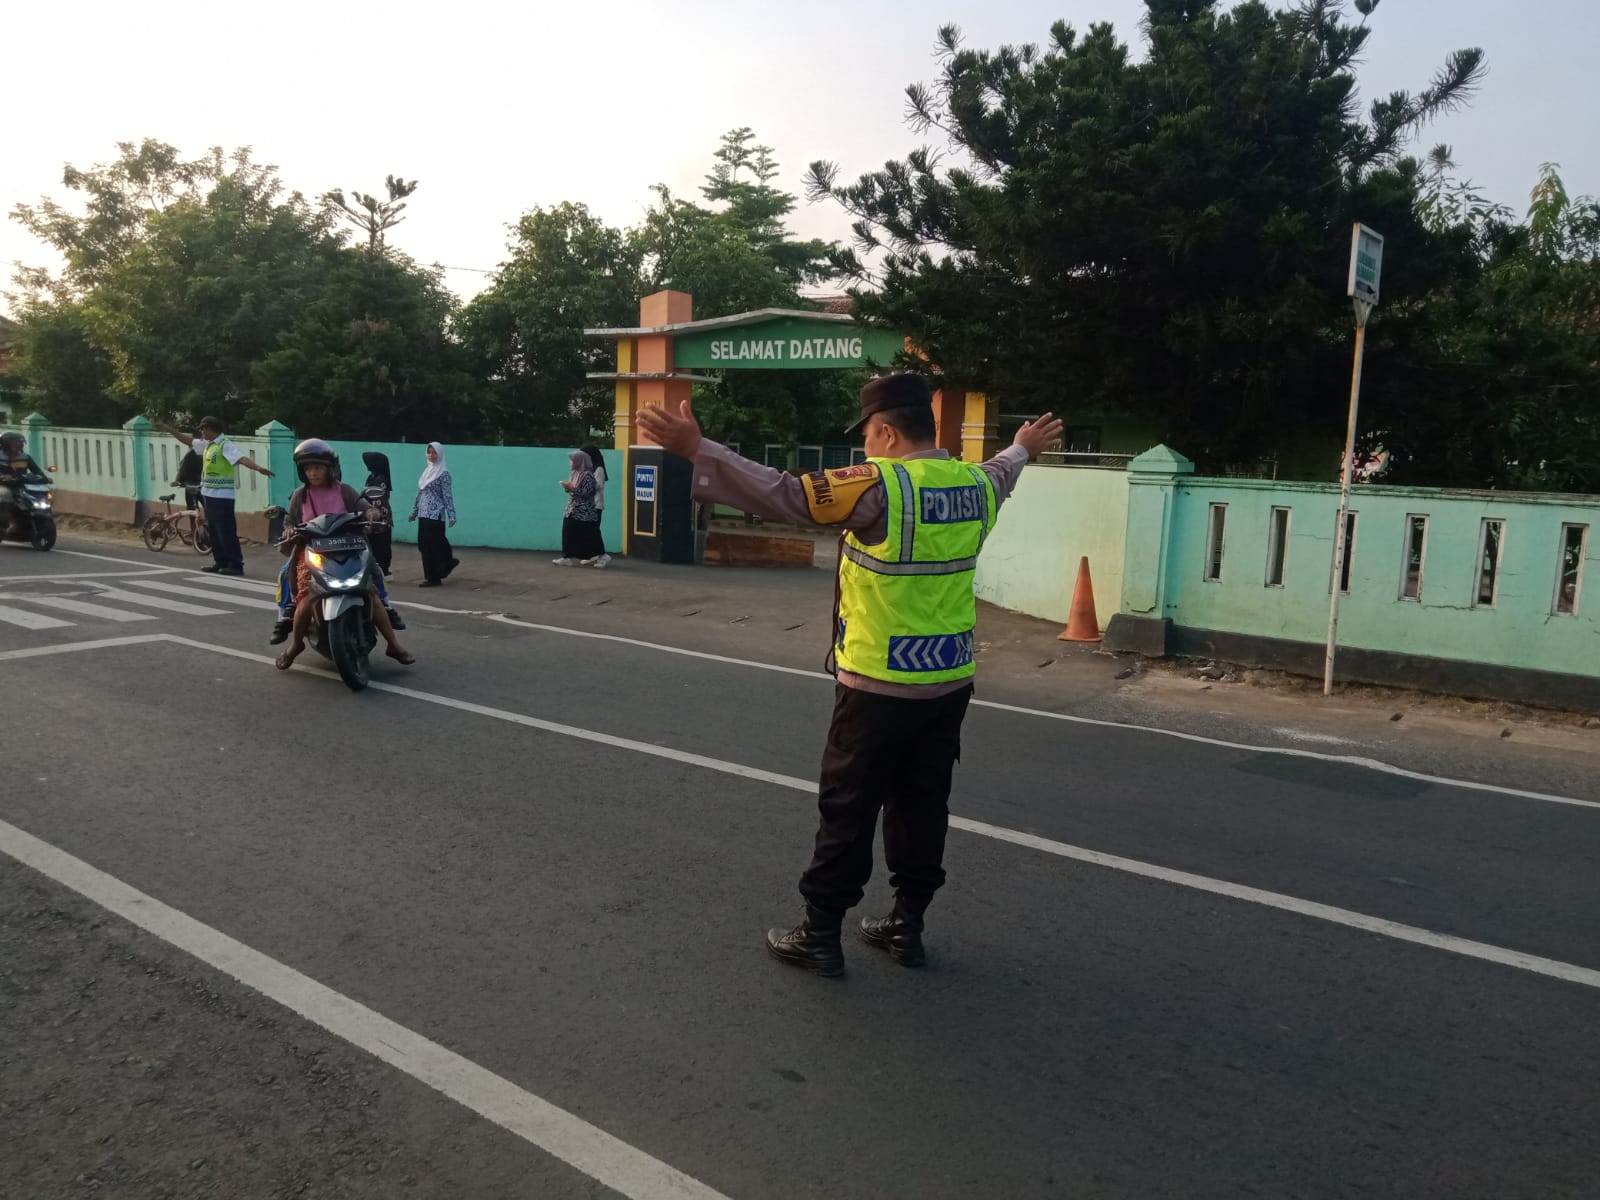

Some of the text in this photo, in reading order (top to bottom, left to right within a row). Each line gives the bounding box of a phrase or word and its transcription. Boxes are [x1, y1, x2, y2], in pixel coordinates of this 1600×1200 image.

[710, 337, 862, 360] SELAMAT DATANG
[636, 473, 654, 483] PINTU
[636, 490, 653, 498] MASUK
[923, 489, 979, 521] POLISI
